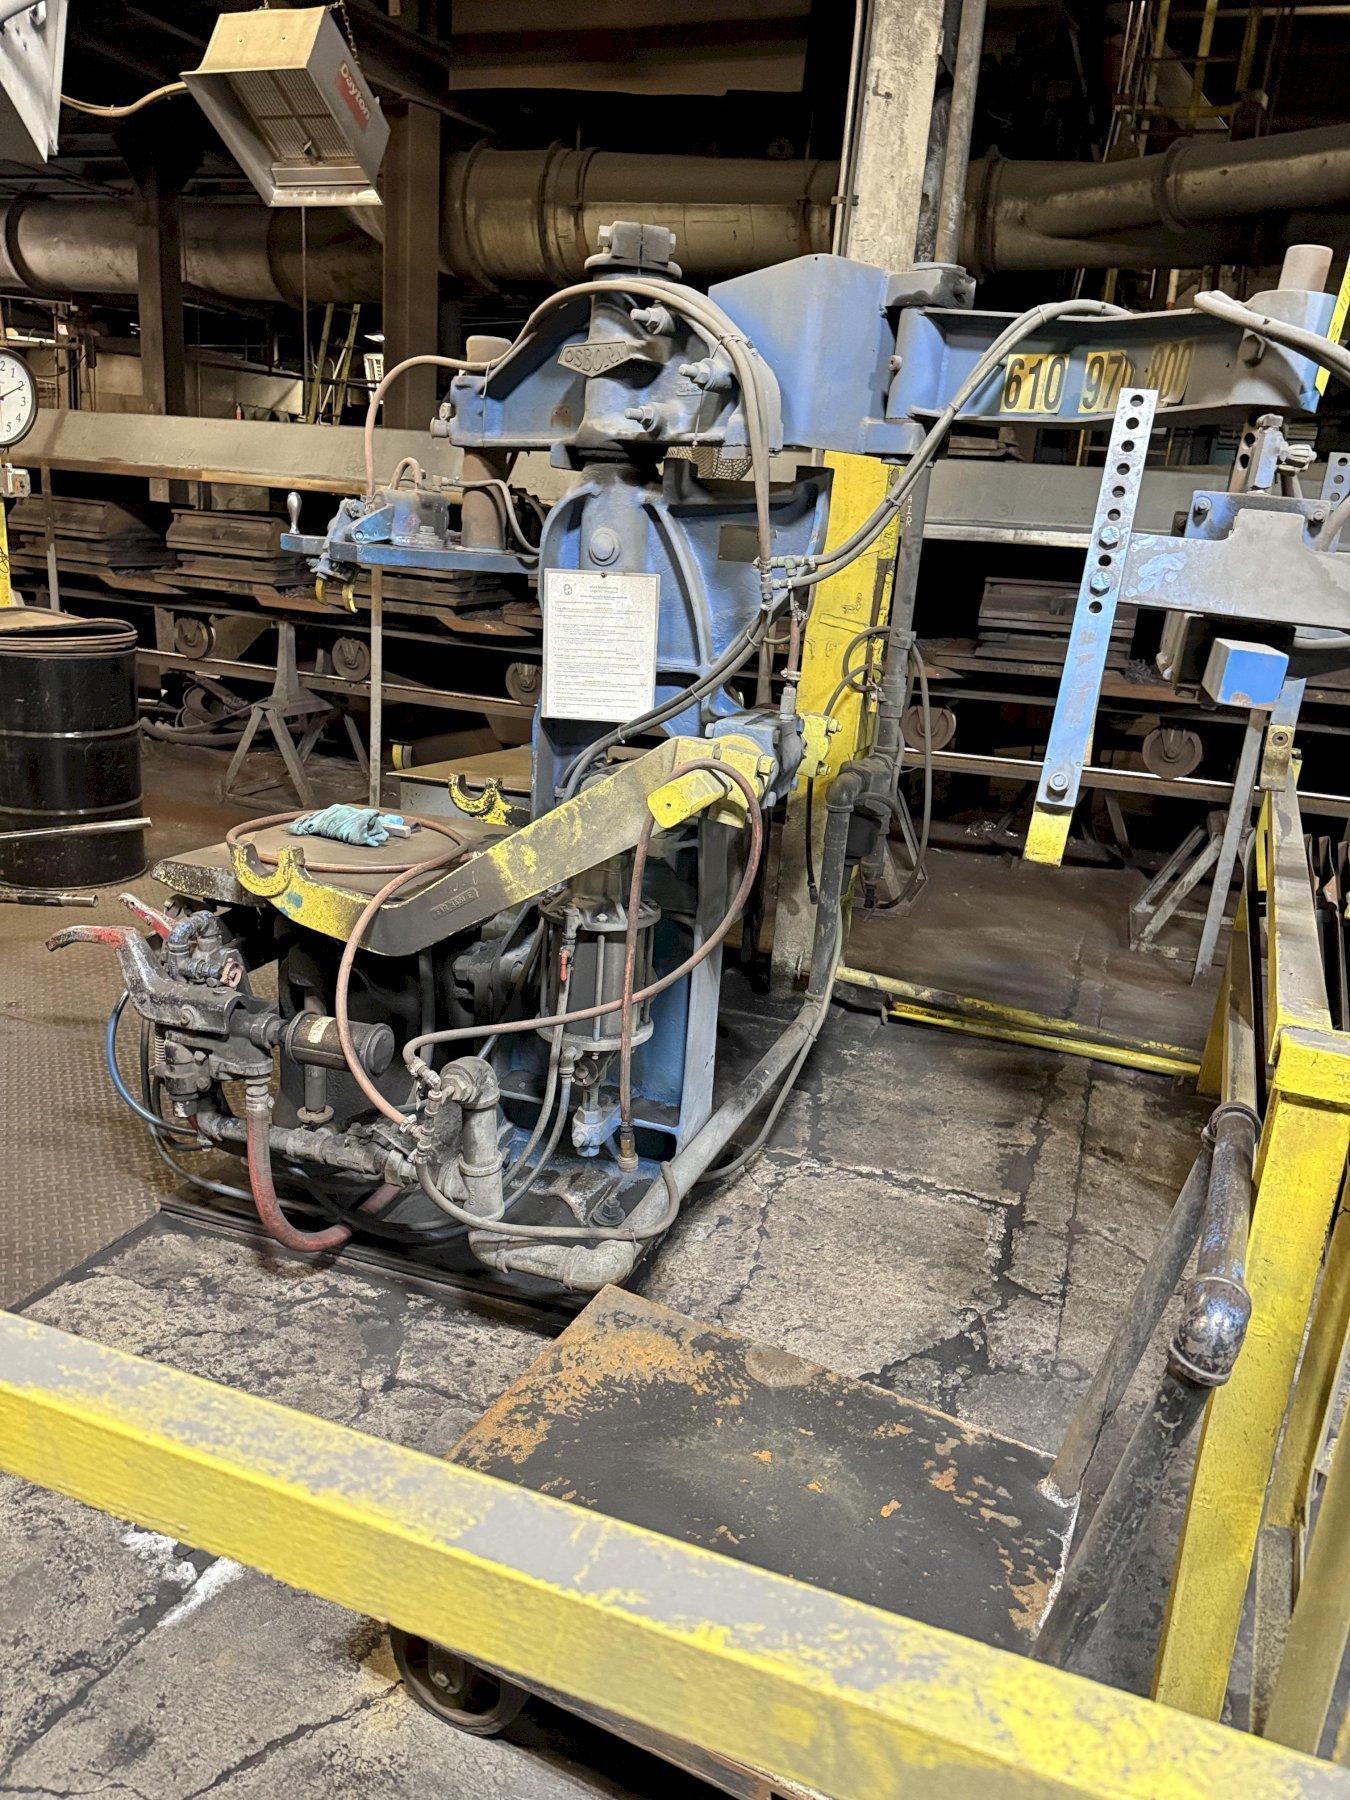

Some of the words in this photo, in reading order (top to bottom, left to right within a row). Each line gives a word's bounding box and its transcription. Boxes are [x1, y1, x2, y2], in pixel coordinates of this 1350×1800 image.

[340, 63, 370, 119] Dayton
[11, 367, 15, 378] 1
[18, 380, 25, 391] 2
[1004, 356, 1066, 410] 610
[20, 396, 26, 407] 3
[15, 413, 21, 423] 4
[6, 422, 12, 432] 5
[905, 494, 913, 528] AIR
